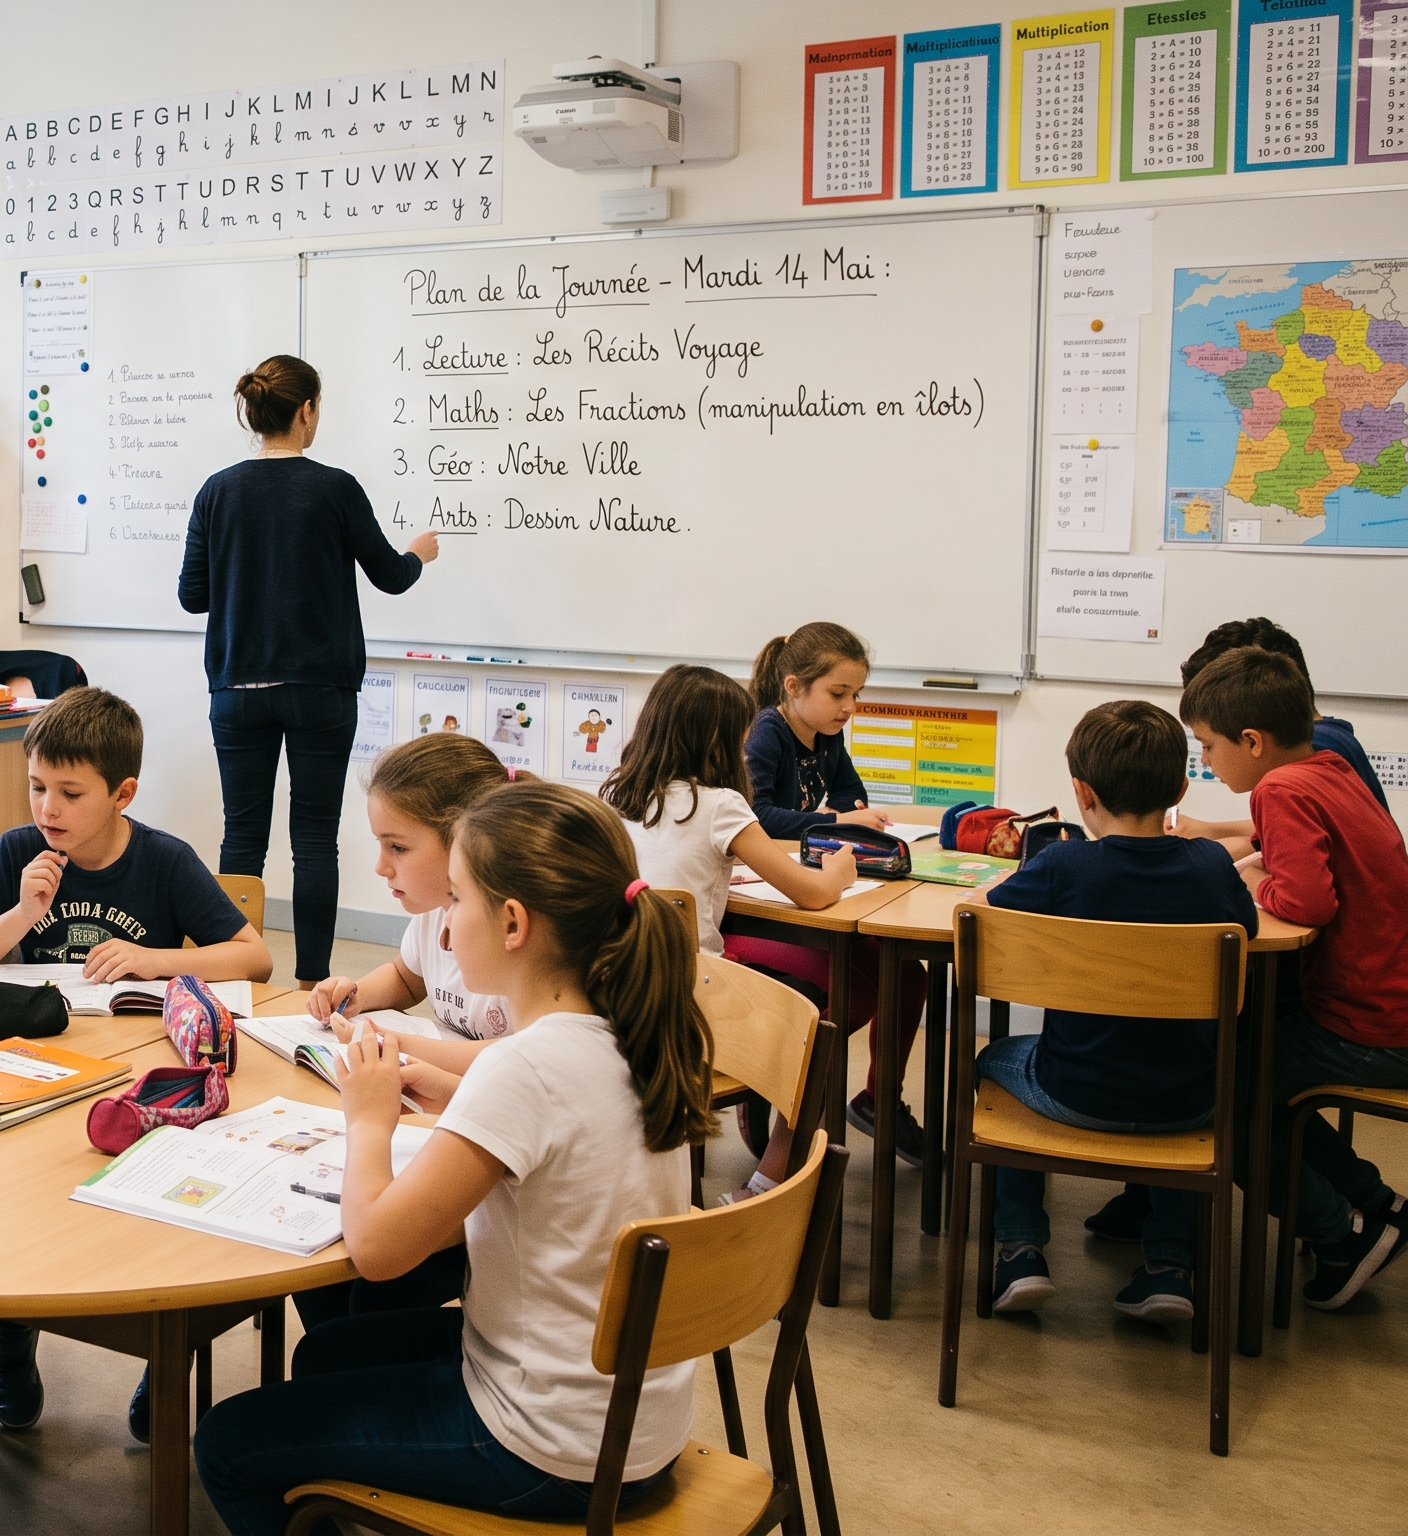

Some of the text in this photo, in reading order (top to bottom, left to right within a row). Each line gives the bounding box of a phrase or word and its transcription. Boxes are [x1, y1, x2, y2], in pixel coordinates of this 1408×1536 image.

[1267, 23, 1321, 37] 3 2 11
[1267, 35, 1321, 49] 2 4 21
[1037, 53, 1043, 61] 3
[1073, 48, 1085, 58] 12
[1150, 47, 1202, 61] 2 4 10
[1285, 86, 1293, 95] 6
[1306, 84, 1320, 93] 34
[4, 69, 496, 143] A B B C D E F G H I J K L M I J K L L M N
[1168, 97, 1175, 106] 6
[1187, 95, 1201, 103] 46
[1072, 106, 1084, 115] 24
[1258, 148, 1271, 157] 10
[1303, 143, 1325, 154] 200
[1380, 139, 1394, 148] 10
[1143, 154, 1204, 166] 10 100
[1070, 163, 1083, 172] 90
[5, 154, 494, 216] 0 1 2 3 Q R S T T U D R S T T U V W X Y Z
[5, 195, 493, 247] a b c d e f h j h l m n q r t u v w x y z
[404, 269, 467, 305] Plan
[478, 274, 506, 302] de
[516, 264, 542, 300] la
[552, 263, 651, 318] Journée
[683, 254, 762, 291] Mardi
[774, 254, 809, 290] 14
[822, 246, 875, 282] Mai
[392, 345, 411, 373] 1.
[423, 335, 509, 371] Lecture
[532, 331, 573, 366] Les
[583, 328, 660, 363] Récits
[673, 323, 764, 379] Voyage
[392, 397, 415, 425] 2.
[429, 390, 499, 424] Maths
[525, 387, 565, 423] Les
[578, 388, 687, 422] Fractions
[697, 385, 867, 436] (manipulation
[876, 400, 905, 417] en
[914, 377, 985, 429] îlots)
[393, 448, 415, 476] 3.
[428, 444, 473, 476] Géo
[497, 441, 570, 476] Notre
[581, 440, 642, 476] Ville
[392, 500, 414, 531] 4.
[428, 496, 478, 528] Arts
[503, 497, 580, 531] Dessin
